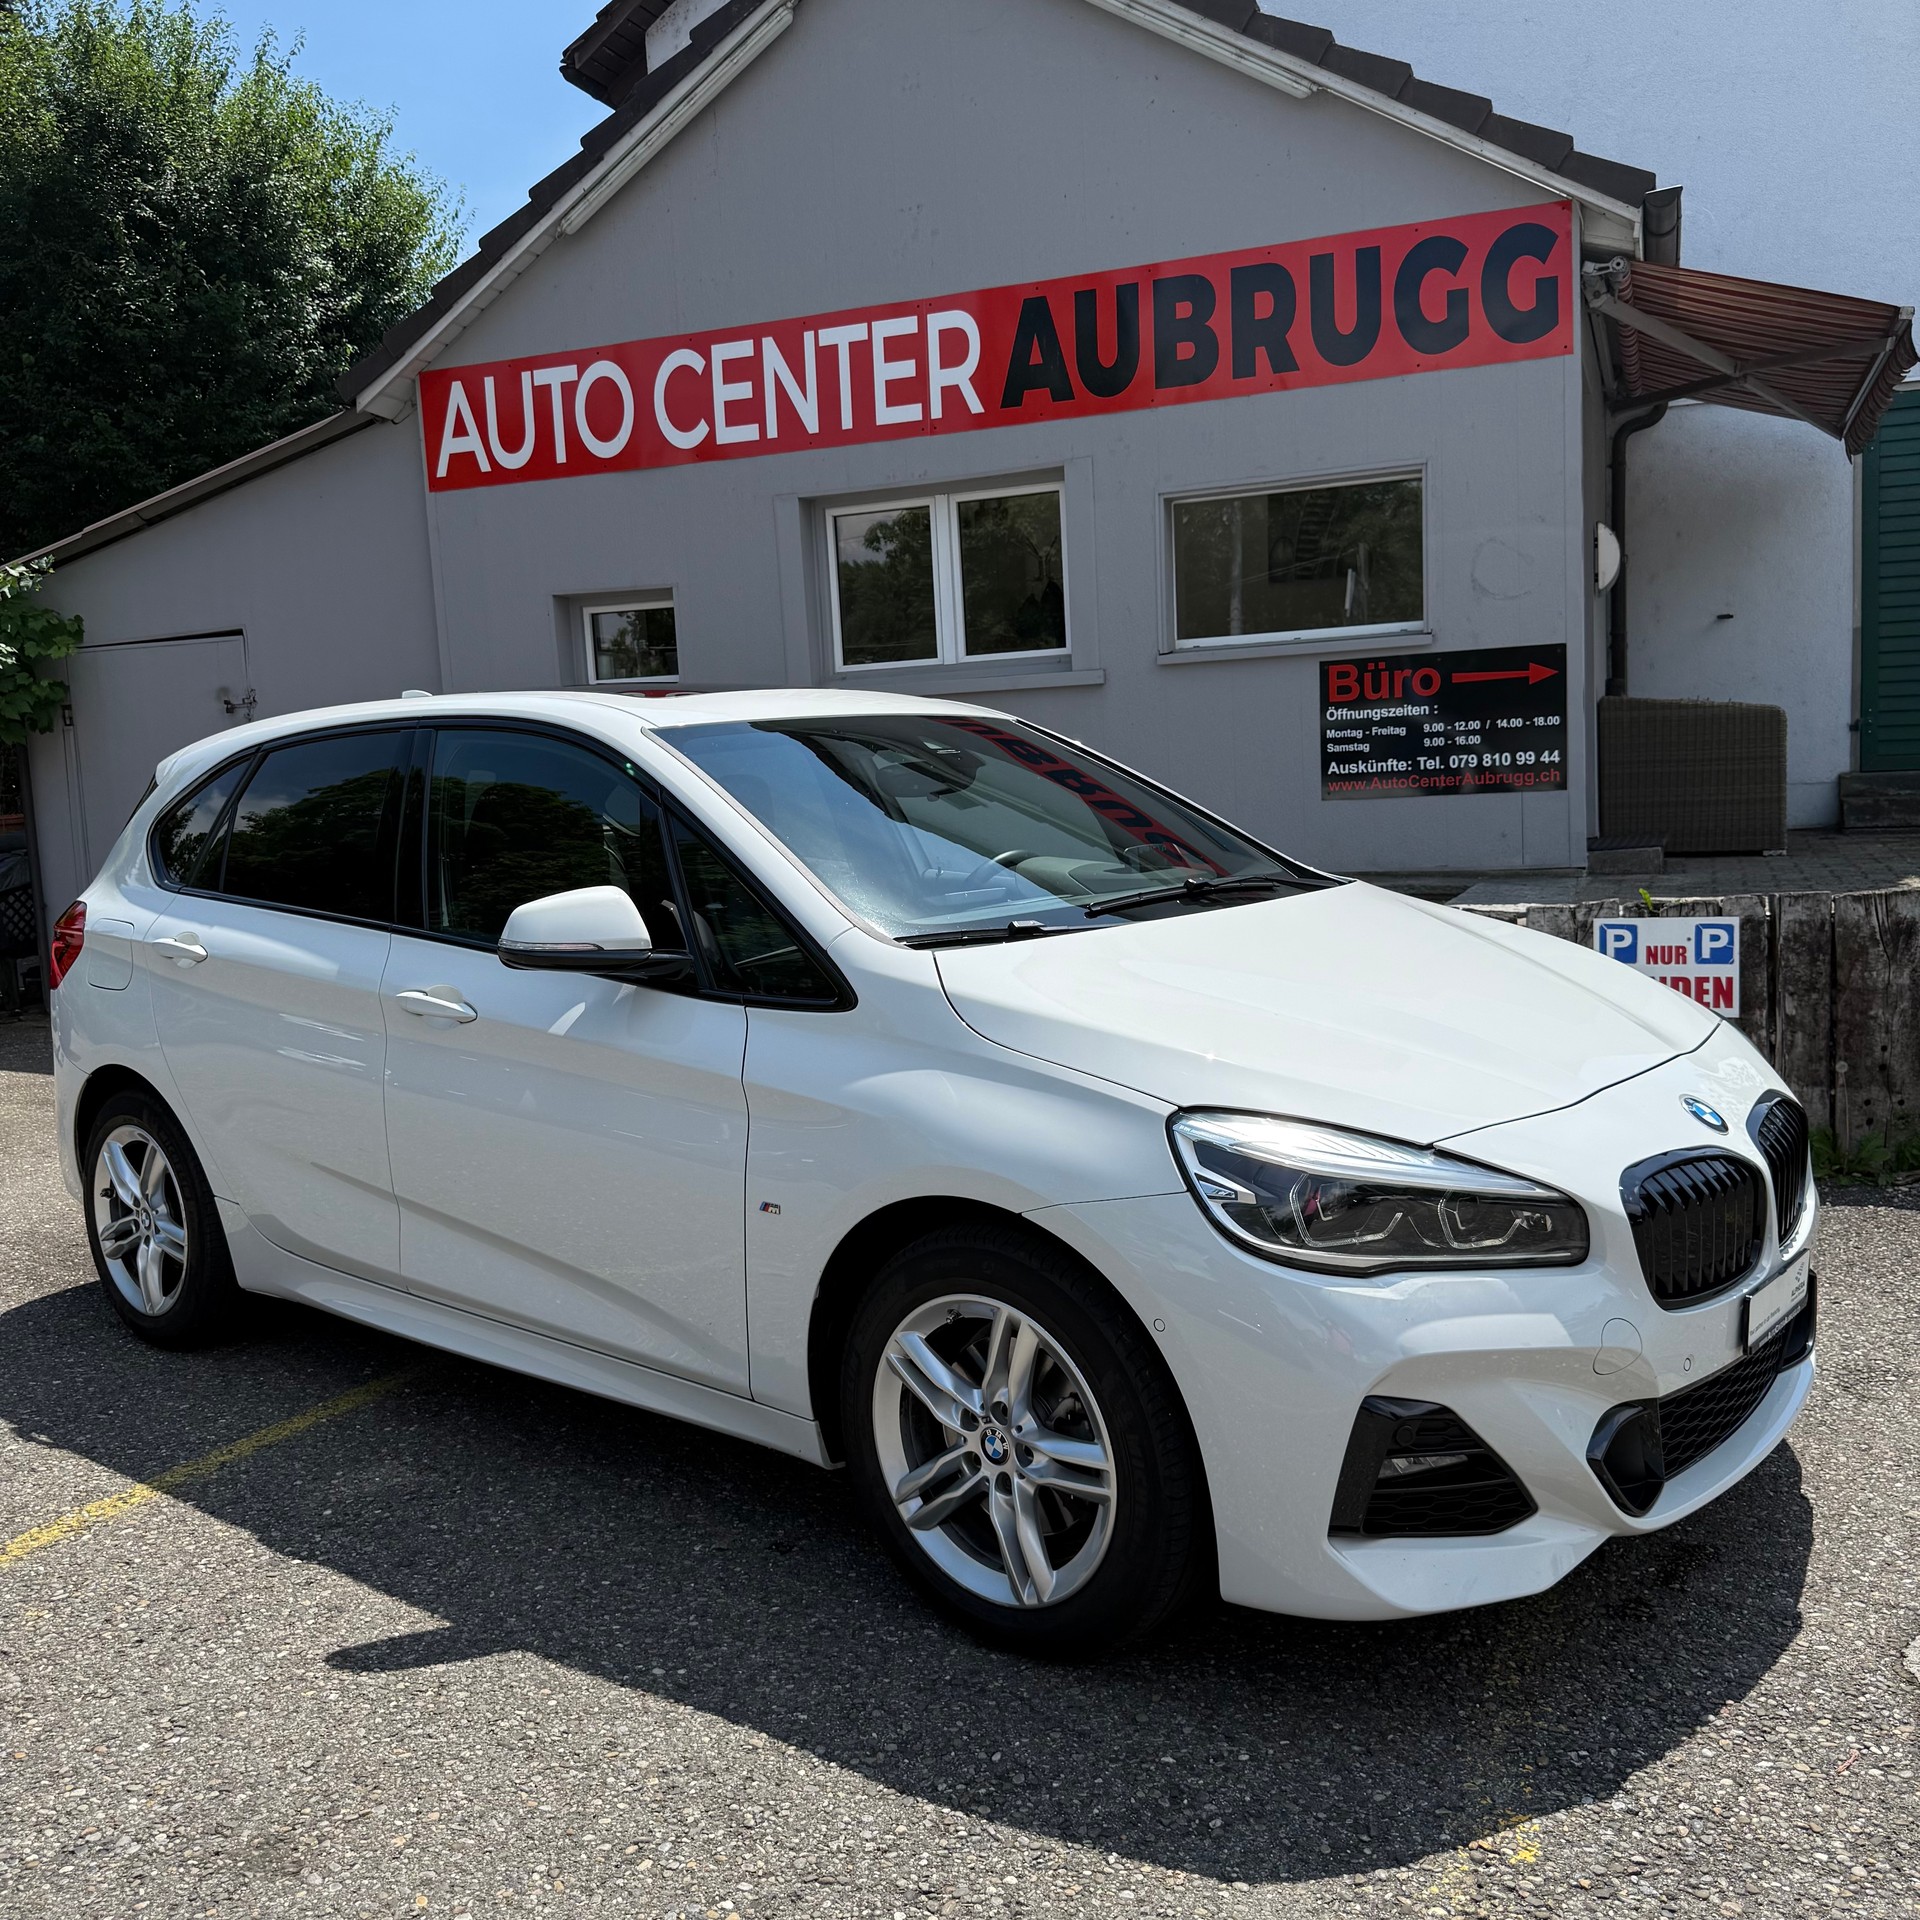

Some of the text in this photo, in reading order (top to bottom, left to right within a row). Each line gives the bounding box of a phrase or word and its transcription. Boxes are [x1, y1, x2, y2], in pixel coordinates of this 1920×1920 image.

[436, 222, 1560, 478] AUTO CENTER AUBRUGG
[1328, 662, 1441, 703] Büro
[1326, 704, 1429, 721] Öffnungszeiten
[1326, 729, 1363, 739] Montag
[1371, 726, 1407, 737] Freitag
[1423, 723, 1445, 733] 9.00
[1454, 720, 1481, 731] 12.00
[1496, 718, 1523, 729] 14.00
[1533, 715, 1560, 726] 18.00
[1326, 743, 1370, 753] Samstag
[1423, 737, 1445, 747] 9.00
[1454, 735, 1481, 745] 16.00
[1328, 749, 1561, 775] Auskünfte: Tel. 079 810 99 44
[1328, 769, 1561, 792] www.AutoCenterAubrugg.ch
[1645, 945, 1687, 965] NUR
